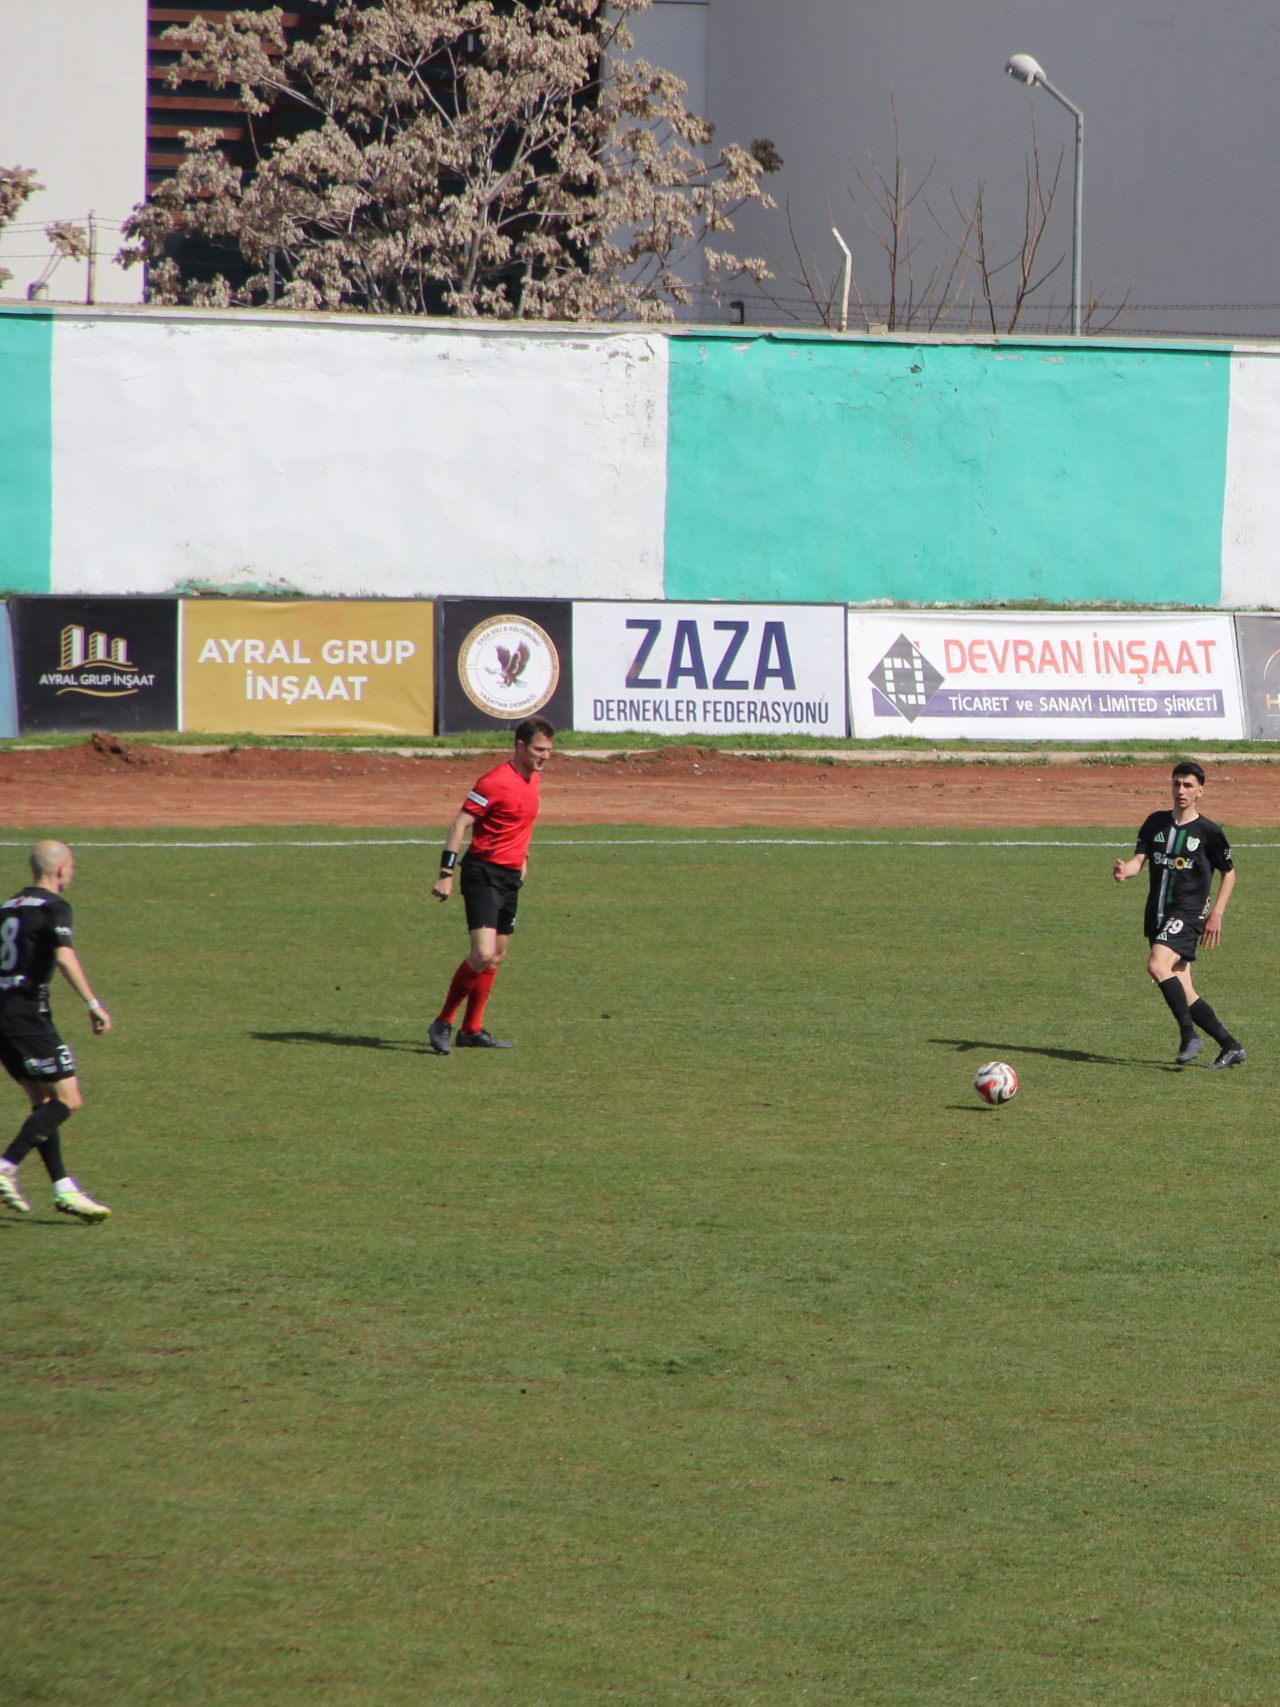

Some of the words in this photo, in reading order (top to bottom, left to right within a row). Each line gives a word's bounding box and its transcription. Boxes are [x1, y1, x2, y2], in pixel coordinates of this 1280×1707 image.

[199, 638, 311, 664] AYRAL
[321, 638, 416, 665] GRUP
[624, 619, 797, 691] ZAZA
[943, 638, 1083, 675] DEVRAN
[1094, 631, 1216, 684] İNŞAAT
[38, 673, 79, 685] AYRAL
[80, 673, 112, 685] GRUP
[113, 672, 155, 688] İNŞAAT
[246, 669, 368, 705] İNŞAAT
[593, 699, 698, 722] DERNEKLER
[702, 700, 830, 724] FEDERASYONU
[948, 693, 1010, 713] TİCARET
[1015, 700, 1034, 713] ve
[1039, 693, 1093, 713] SANAYİ
[1098, 693, 1158, 714] LİMİTED
[1163, 693, 1218, 716] ŞİRKETİ
